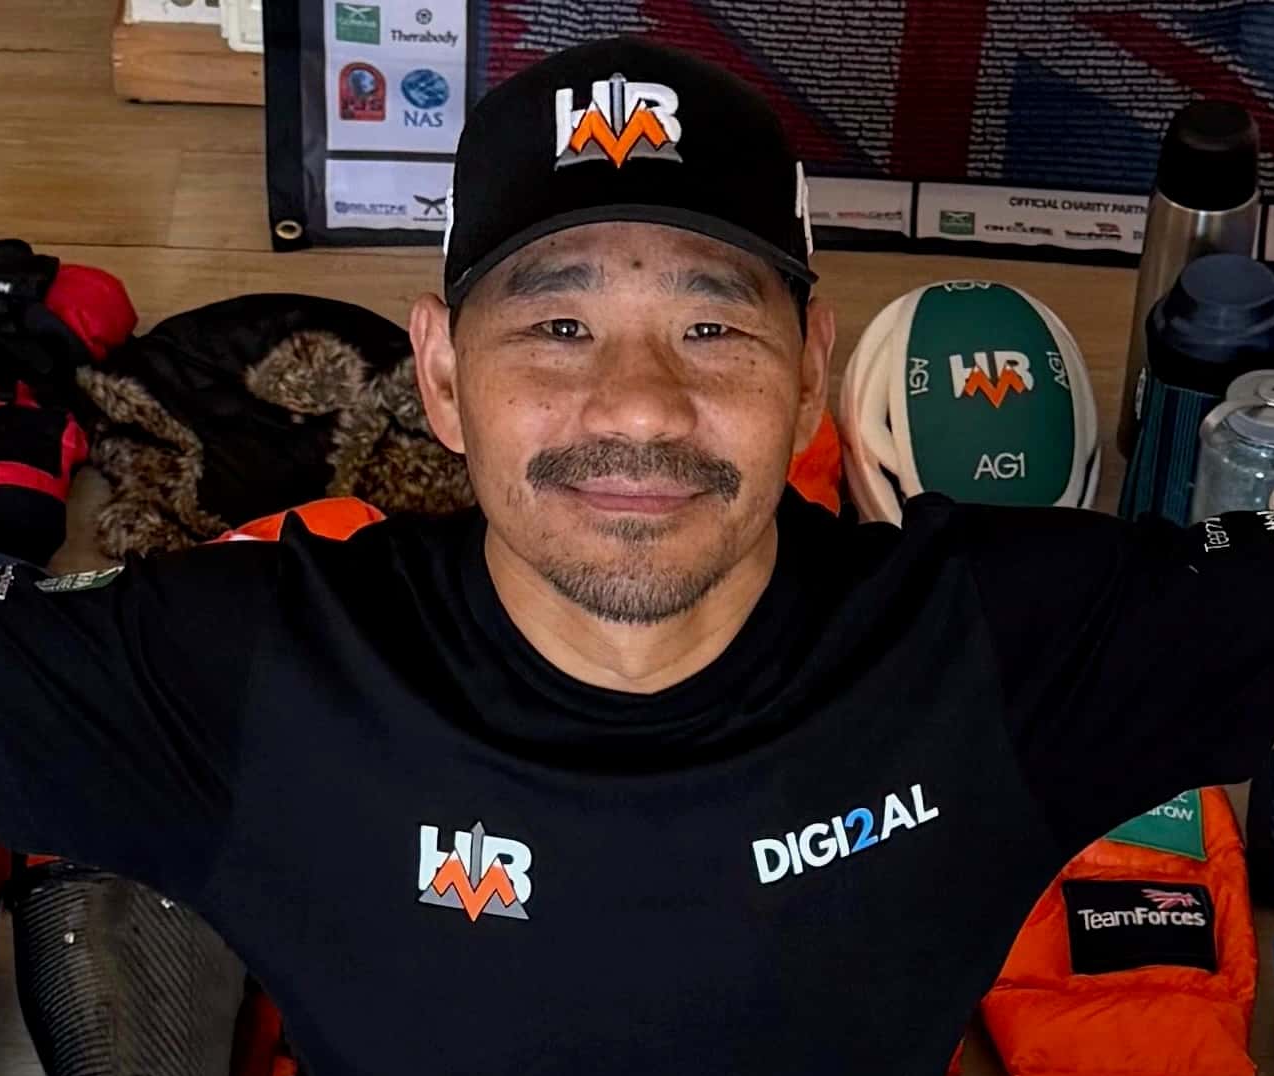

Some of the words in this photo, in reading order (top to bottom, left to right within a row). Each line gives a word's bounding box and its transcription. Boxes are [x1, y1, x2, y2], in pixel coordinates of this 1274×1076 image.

[390, 29, 458, 48] Therabody
[404, 110, 444, 128] NAS
[909, 357, 930, 395] AG1
[973, 452, 1026, 481] AG1
[752, 784, 940, 884] DIGI2AL
[1077, 907, 1206, 931] TeamForces
